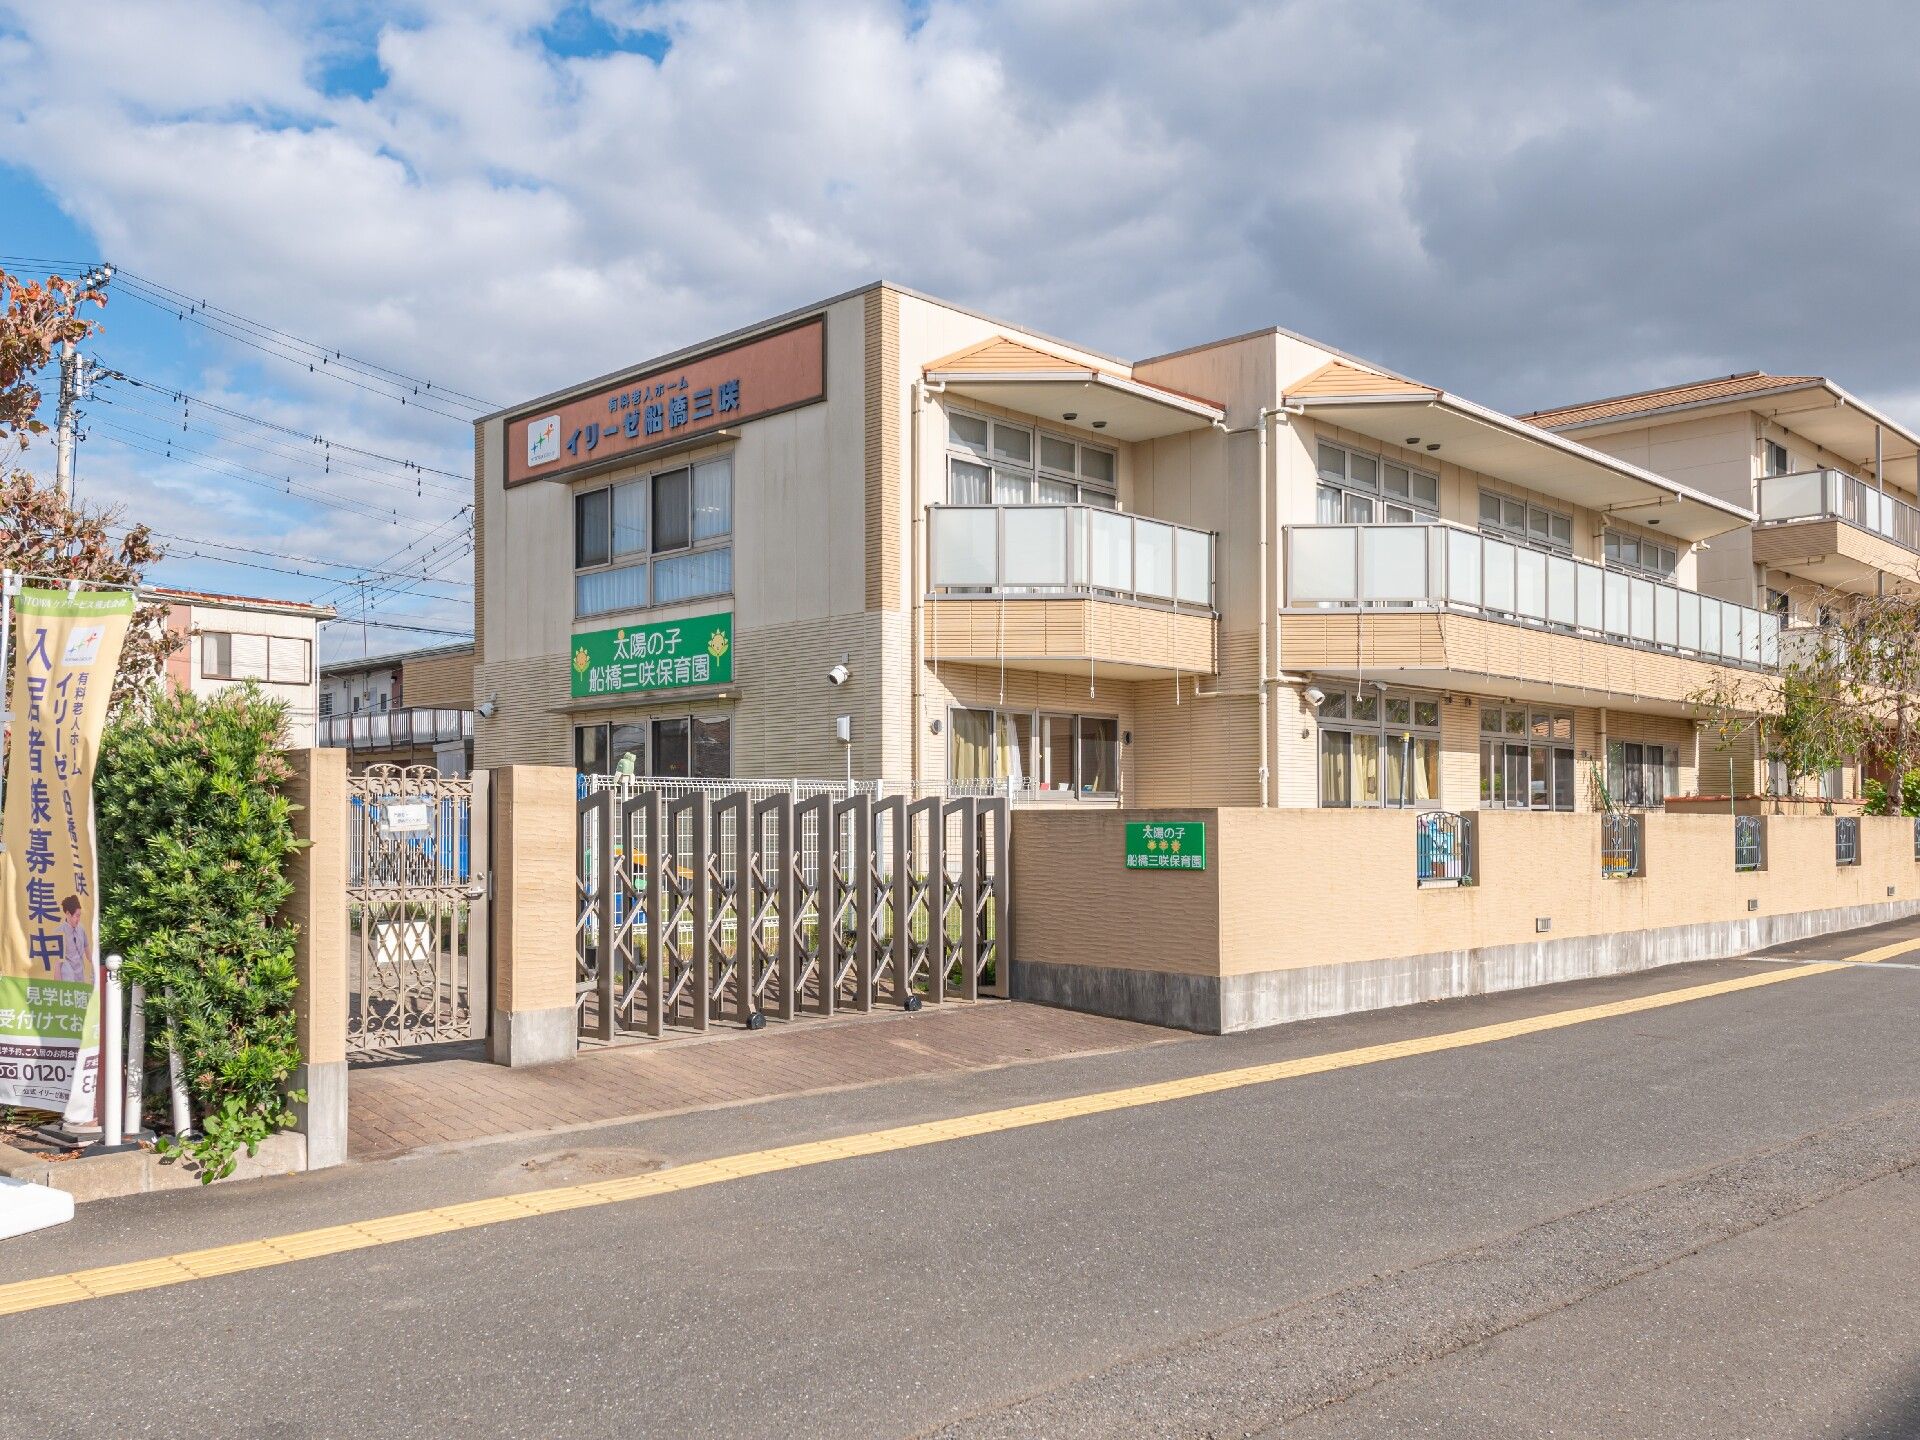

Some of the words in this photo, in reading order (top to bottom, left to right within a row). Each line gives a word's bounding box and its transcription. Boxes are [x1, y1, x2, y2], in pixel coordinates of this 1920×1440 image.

[608, 376, 688, 412] 有料老人ホーム
[566, 379, 740, 455] イリーゼ船橋三咲
[613, 628, 682, 661] 太陽の子
[589, 653, 710, 692] 船橋三咲保育園
[70, 672, 89, 776] 有料老人ホーム
[25, 628, 64, 971] 入居者様募集中
[1143, 825, 1185, 839] 太陽の子
[1127, 854, 1202, 867] 船橋三咲保育園
[26, 986, 91, 1010] 見学は随
[23, 1064, 75, 1082] 0120-
